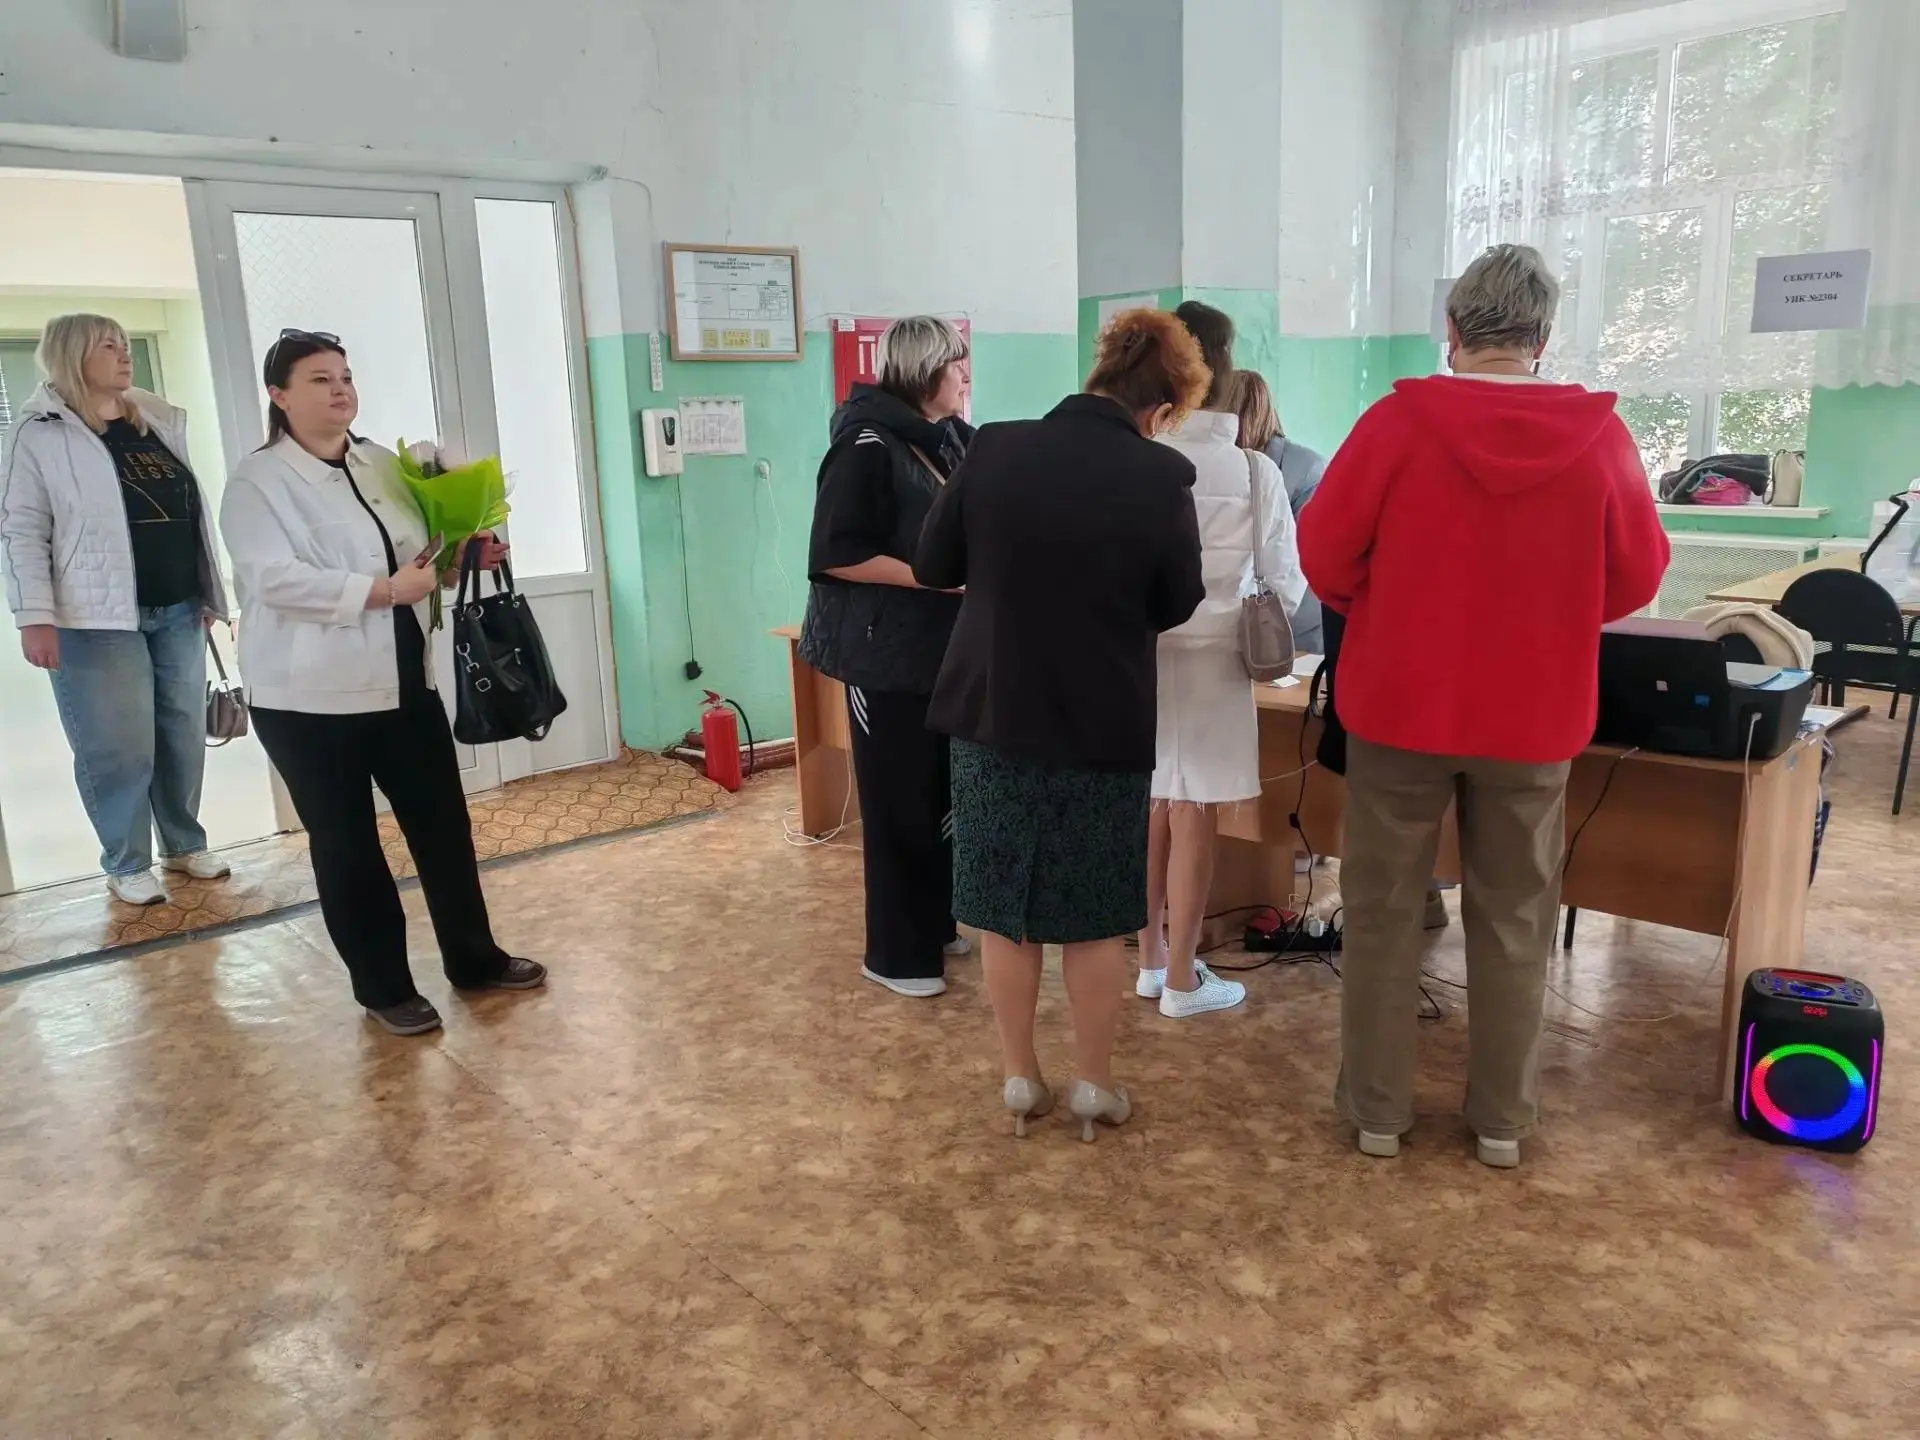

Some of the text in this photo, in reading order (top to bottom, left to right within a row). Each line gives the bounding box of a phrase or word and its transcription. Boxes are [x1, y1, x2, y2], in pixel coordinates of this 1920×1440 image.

[1783, 271, 1843, 283] СЕКРЕТАРЬ
[1784, 295, 1807, 304] УИК
[123, 465, 176, 480] LESS
